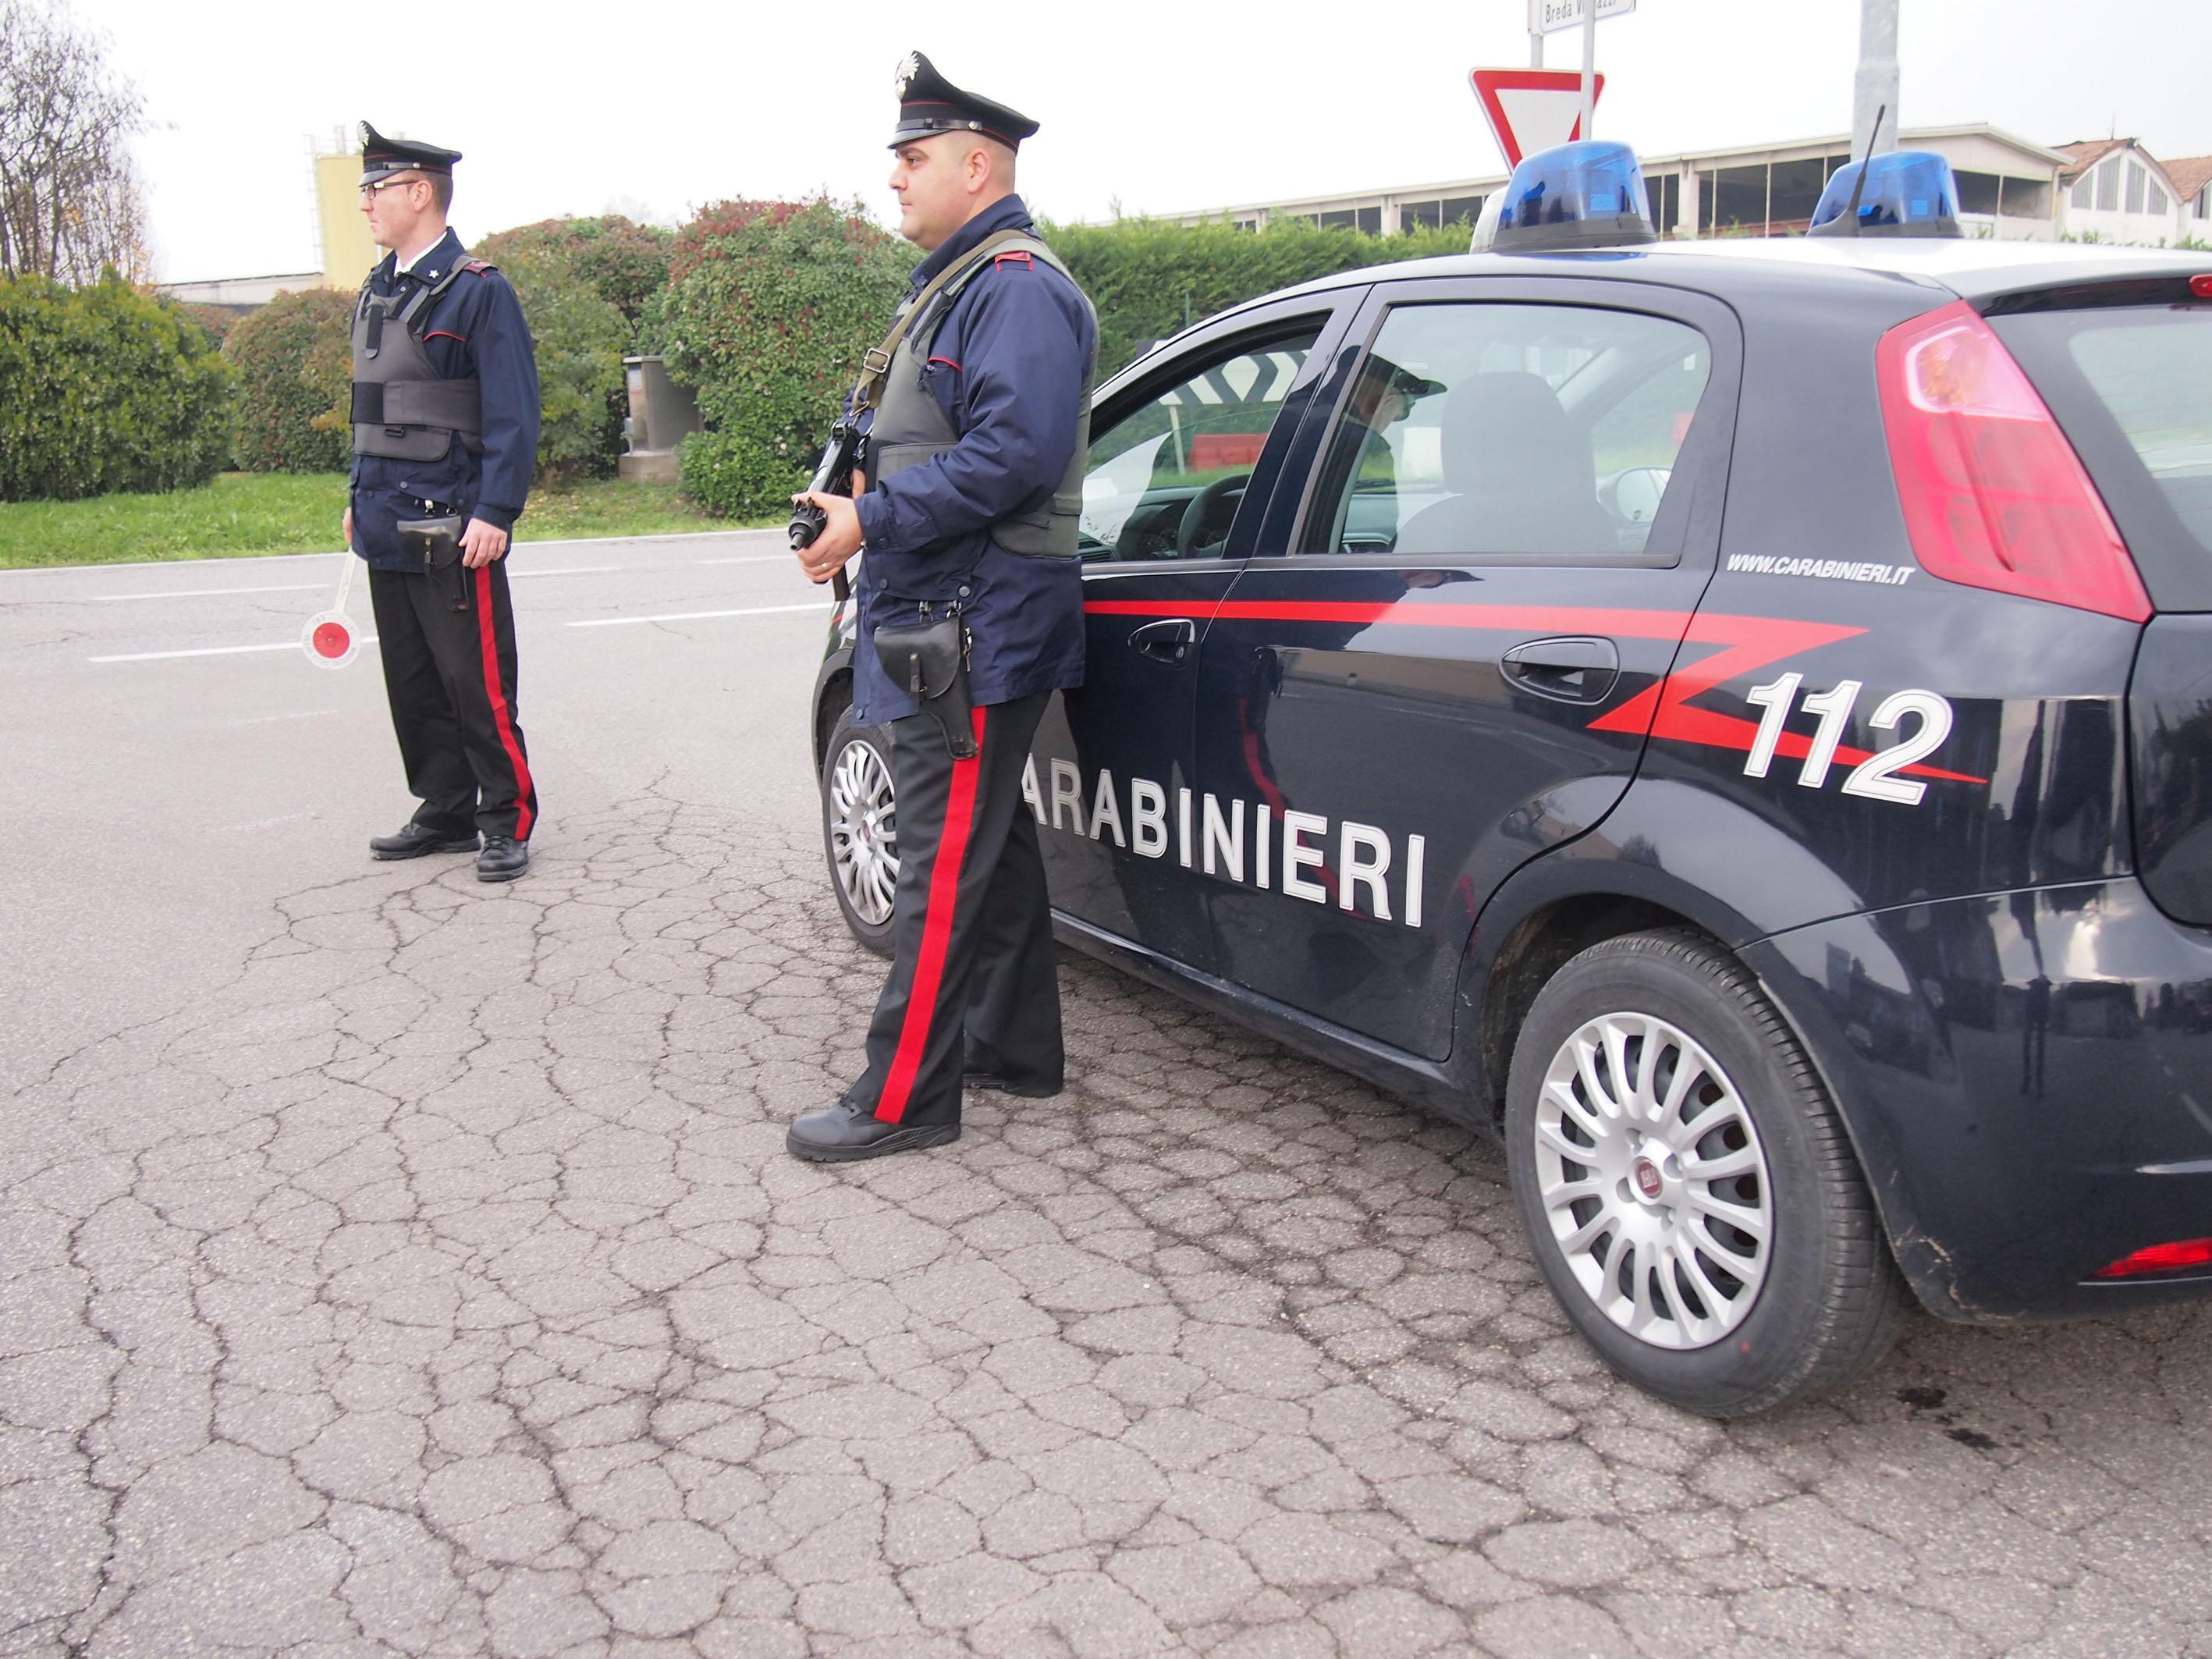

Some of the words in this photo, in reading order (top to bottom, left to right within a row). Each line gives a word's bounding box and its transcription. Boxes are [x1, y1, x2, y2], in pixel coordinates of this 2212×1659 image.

[1546, 0, 1572, 23] Breda
[1727, 553, 1916, 585] WWW.CARABINIERI.IT
[1743, 672, 1954, 806] 112
[1021, 752, 1426, 928] ARABINIERI
